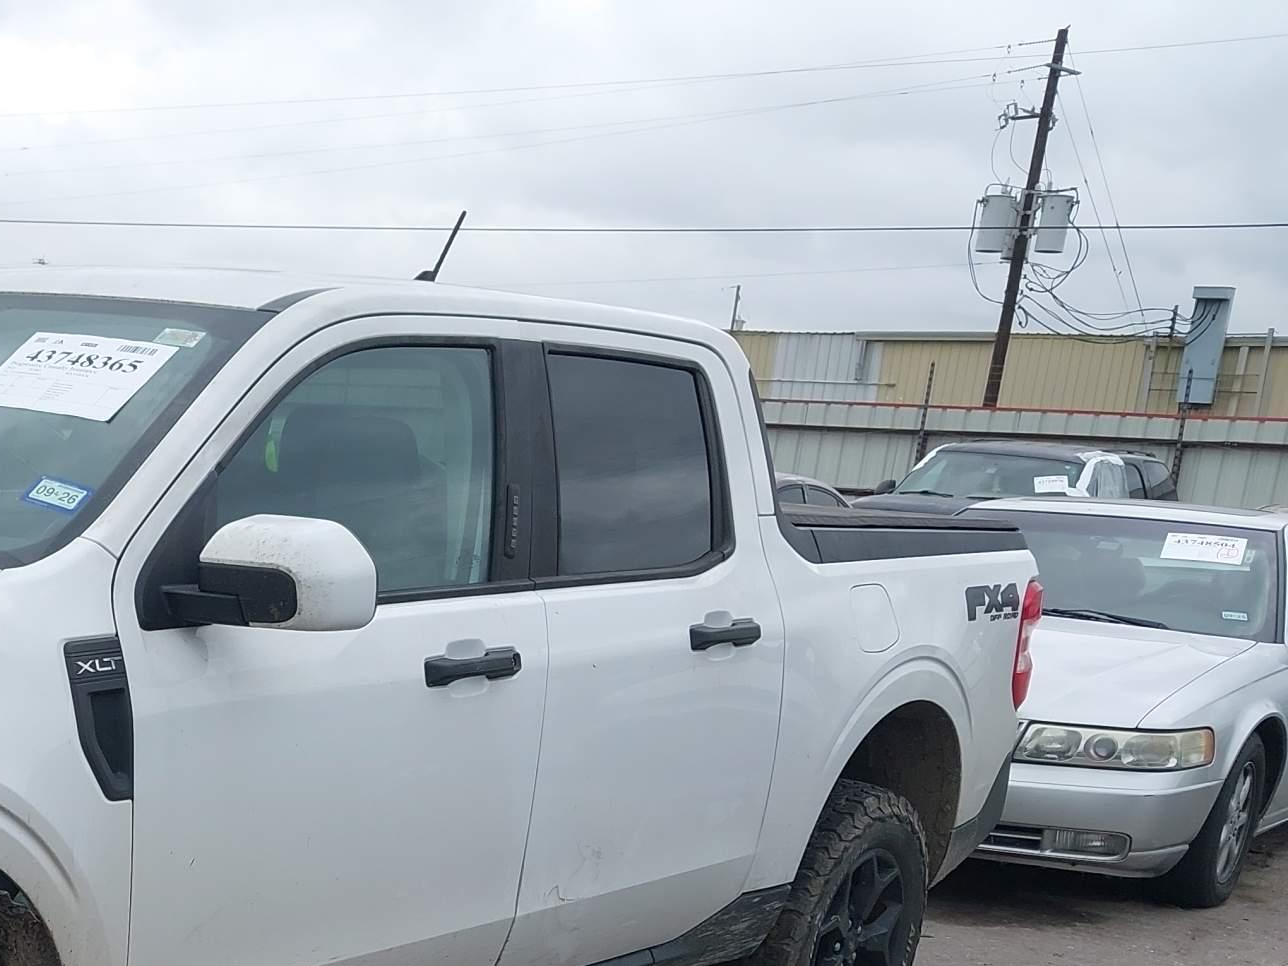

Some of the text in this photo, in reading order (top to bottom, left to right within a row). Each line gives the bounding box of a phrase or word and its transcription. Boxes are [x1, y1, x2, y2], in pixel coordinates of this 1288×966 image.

[25, 348, 145, 374] 43748365
[965, 583, 1020, 621] FX4
[74, 656, 123, 675] XLT
